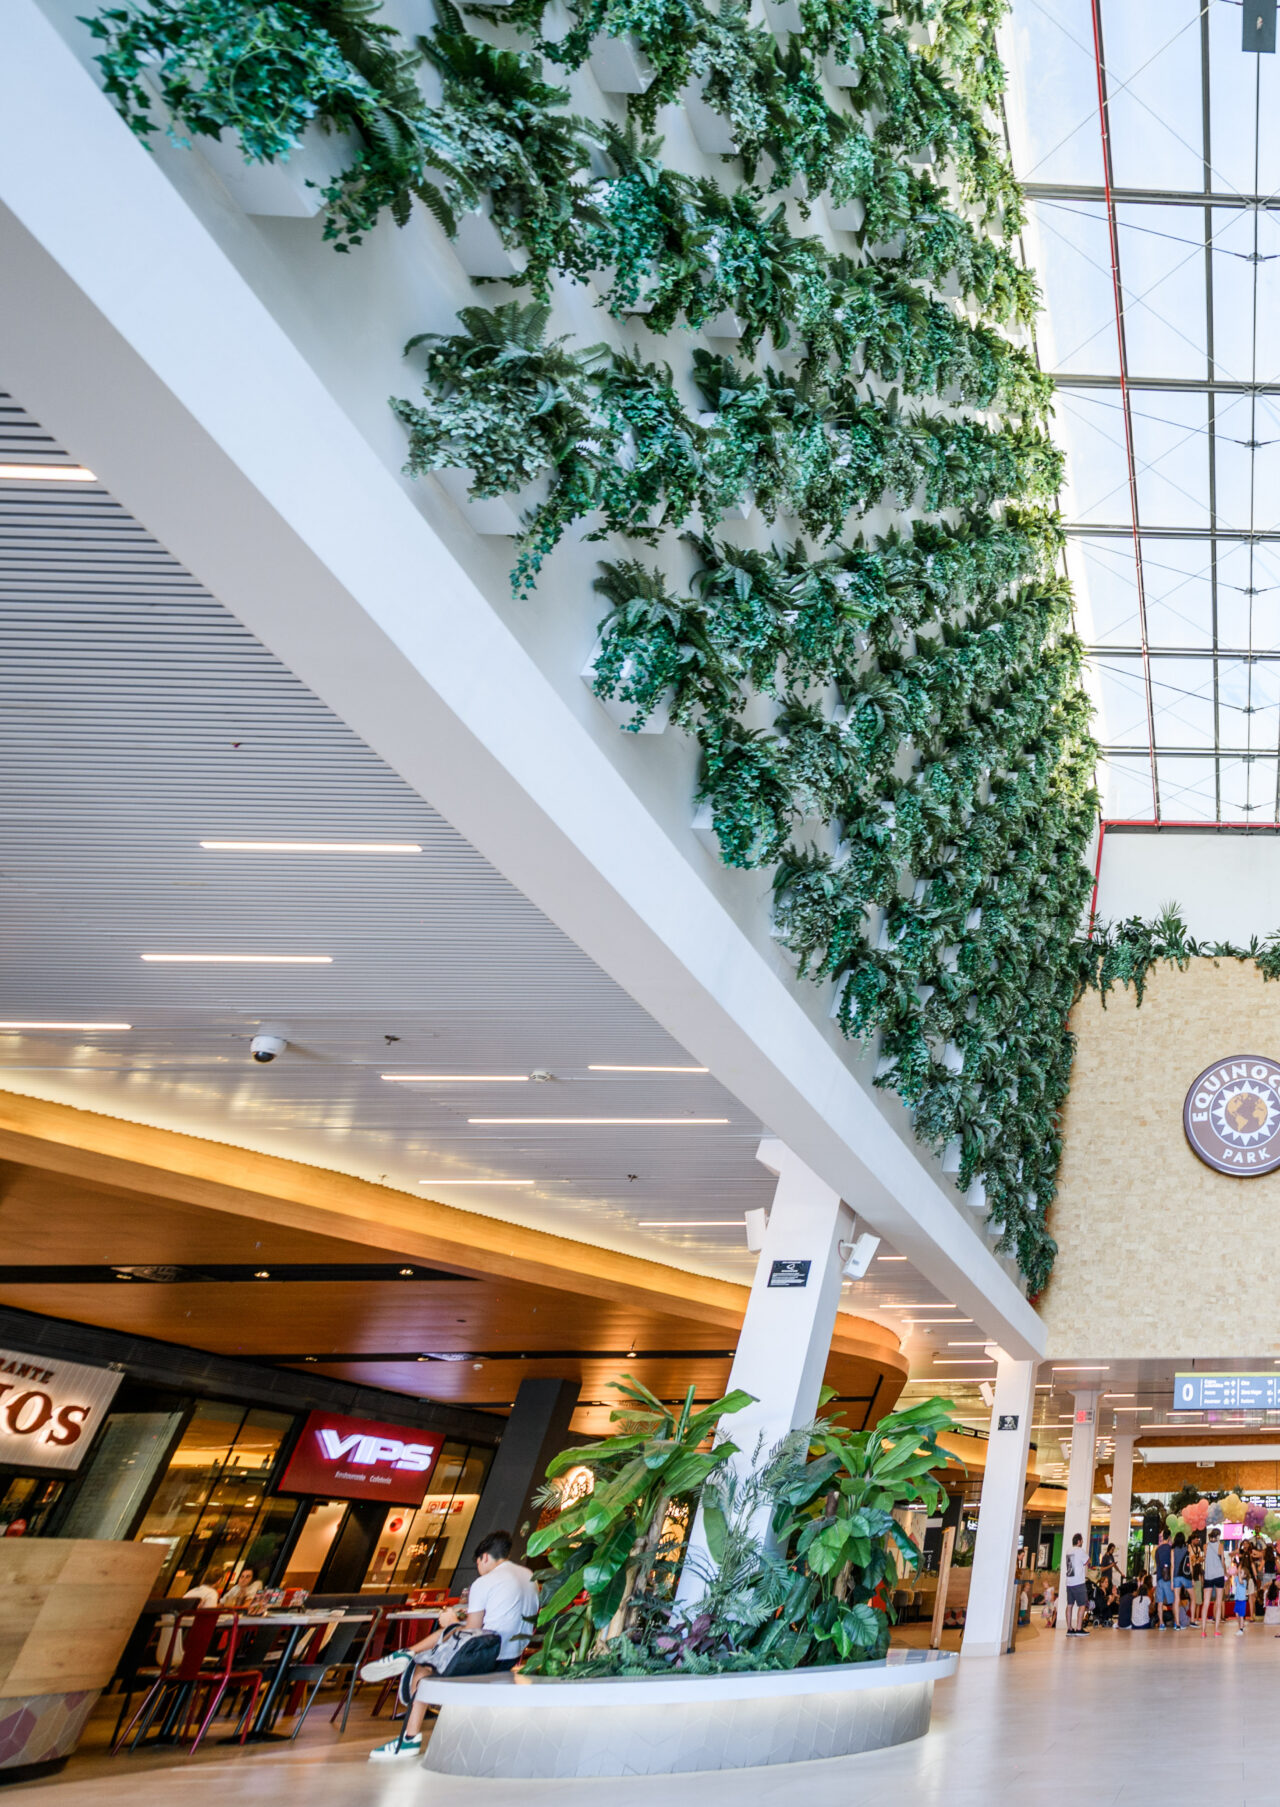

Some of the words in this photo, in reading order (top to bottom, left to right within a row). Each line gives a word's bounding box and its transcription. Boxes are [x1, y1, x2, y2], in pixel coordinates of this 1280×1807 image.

[1222, 1147, 1271, 1164] PARK
[1182, 1383, 1194, 1402] 0
[315, 1428, 435, 1472] VIPS
